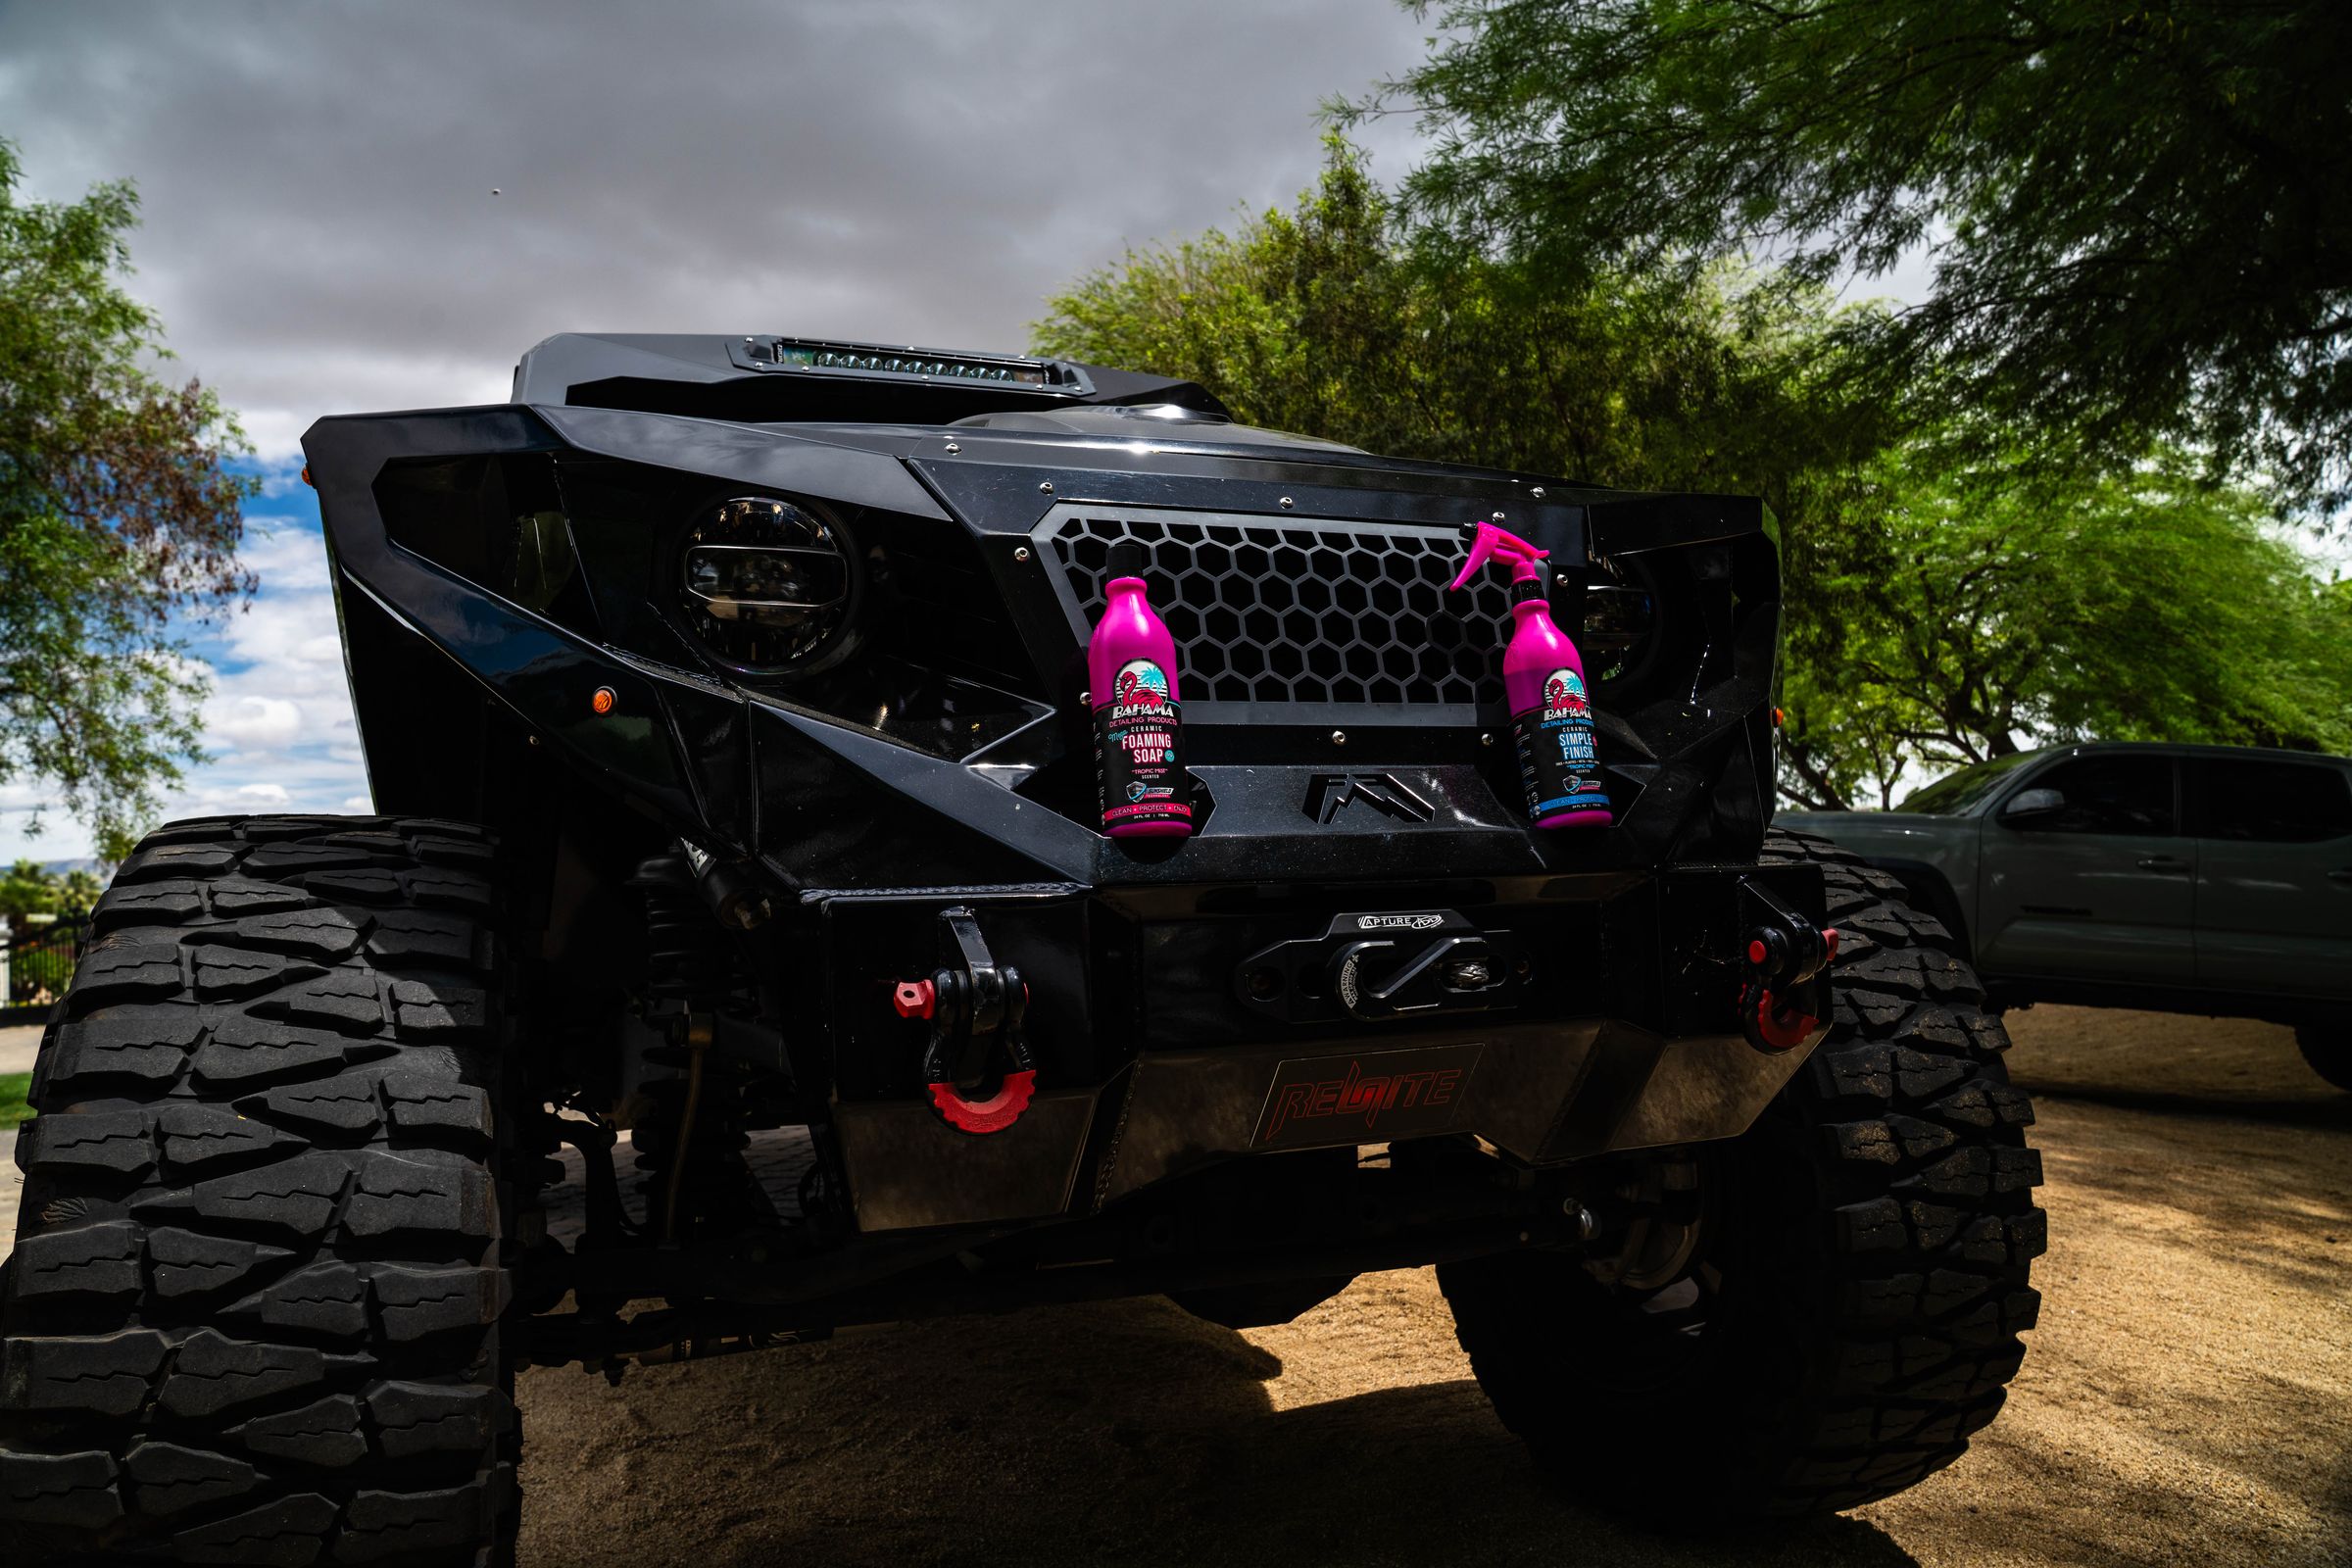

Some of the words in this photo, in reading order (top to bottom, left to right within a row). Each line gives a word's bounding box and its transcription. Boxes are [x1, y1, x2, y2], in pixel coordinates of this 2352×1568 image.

[1112, 704, 1174, 719] BAHAMA
[1544, 707, 1592, 721] BAHAMA
[1108, 716, 1145, 728] DETAILING
[1541, 718, 1574, 729] DETAILING
[1122, 733, 1172, 750] FOAMING
[1558, 733, 1593, 746] SIMPLE
[1134, 749, 1163, 762] SOAP
[1563, 746, 1594, 759] FINISH
[1111, 808, 1132, 816] CLEAN
[1343, 960, 1352, 999] WARNING
